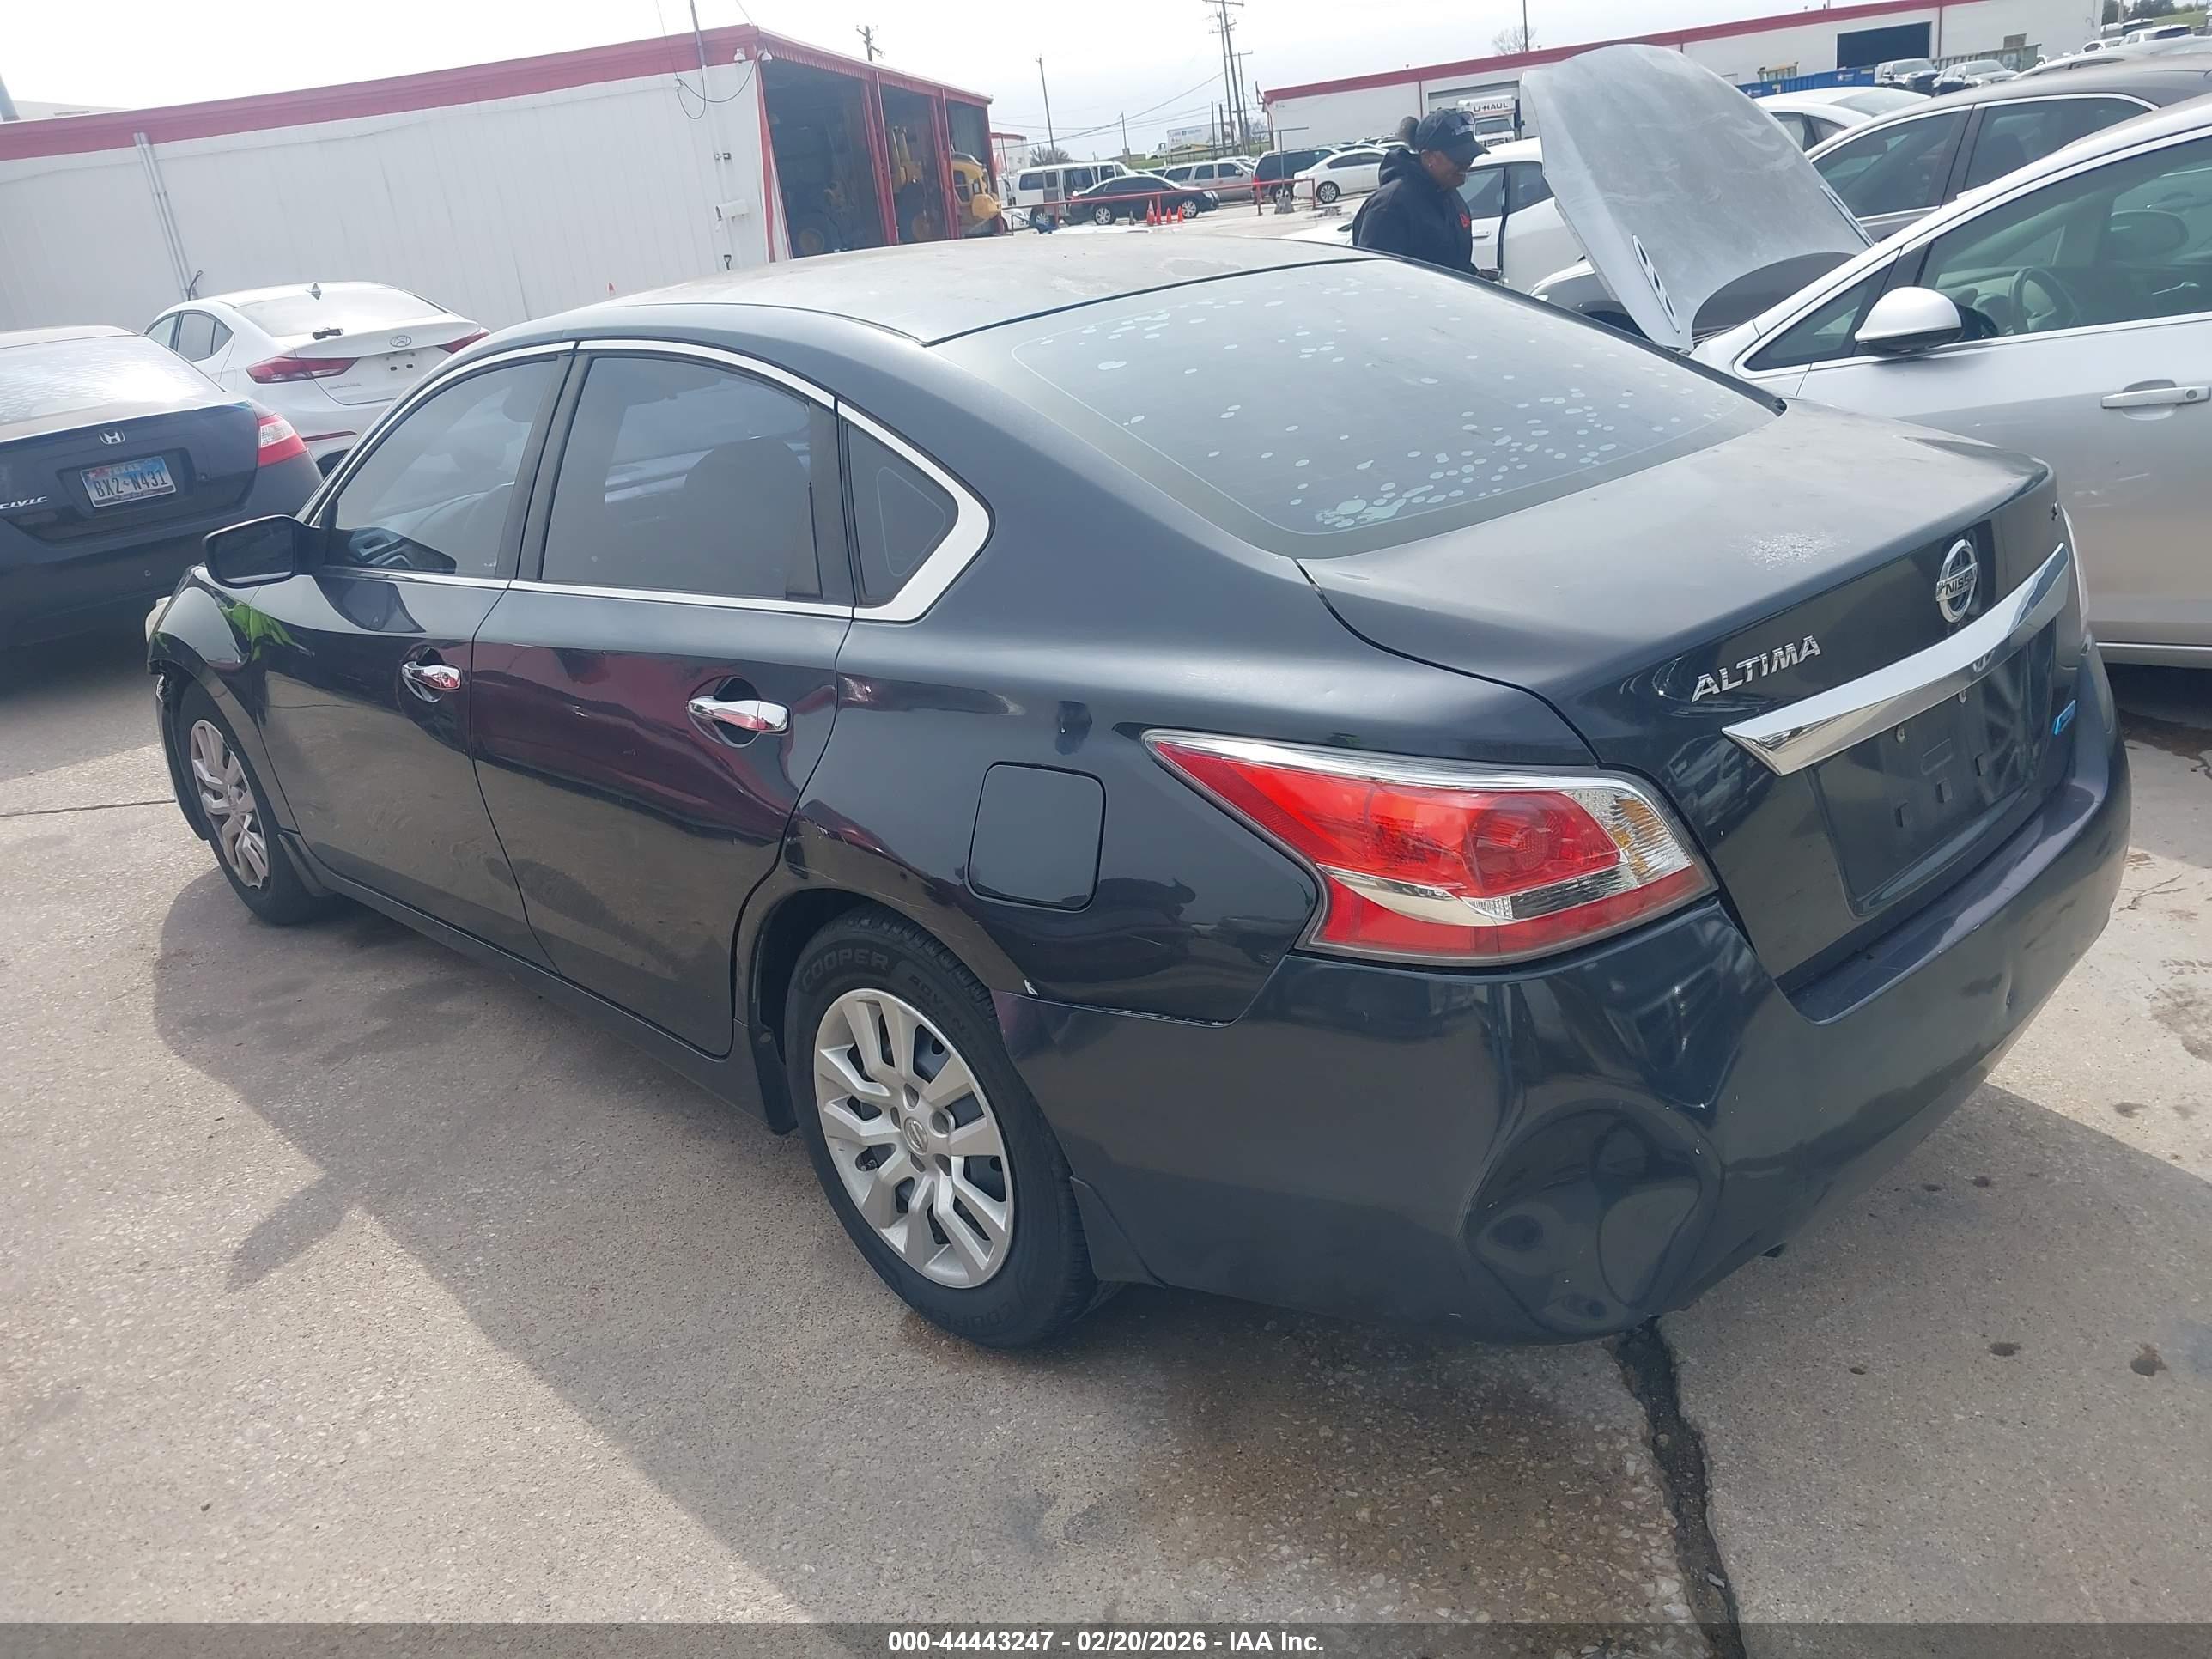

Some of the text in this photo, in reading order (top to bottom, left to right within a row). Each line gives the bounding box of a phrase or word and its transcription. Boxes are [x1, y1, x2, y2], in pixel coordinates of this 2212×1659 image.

[0, 495, 48, 510] CIVIC
[1691, 635, 1821, 702] ALTIMA
[801, 947, 889, 993] COOPER
